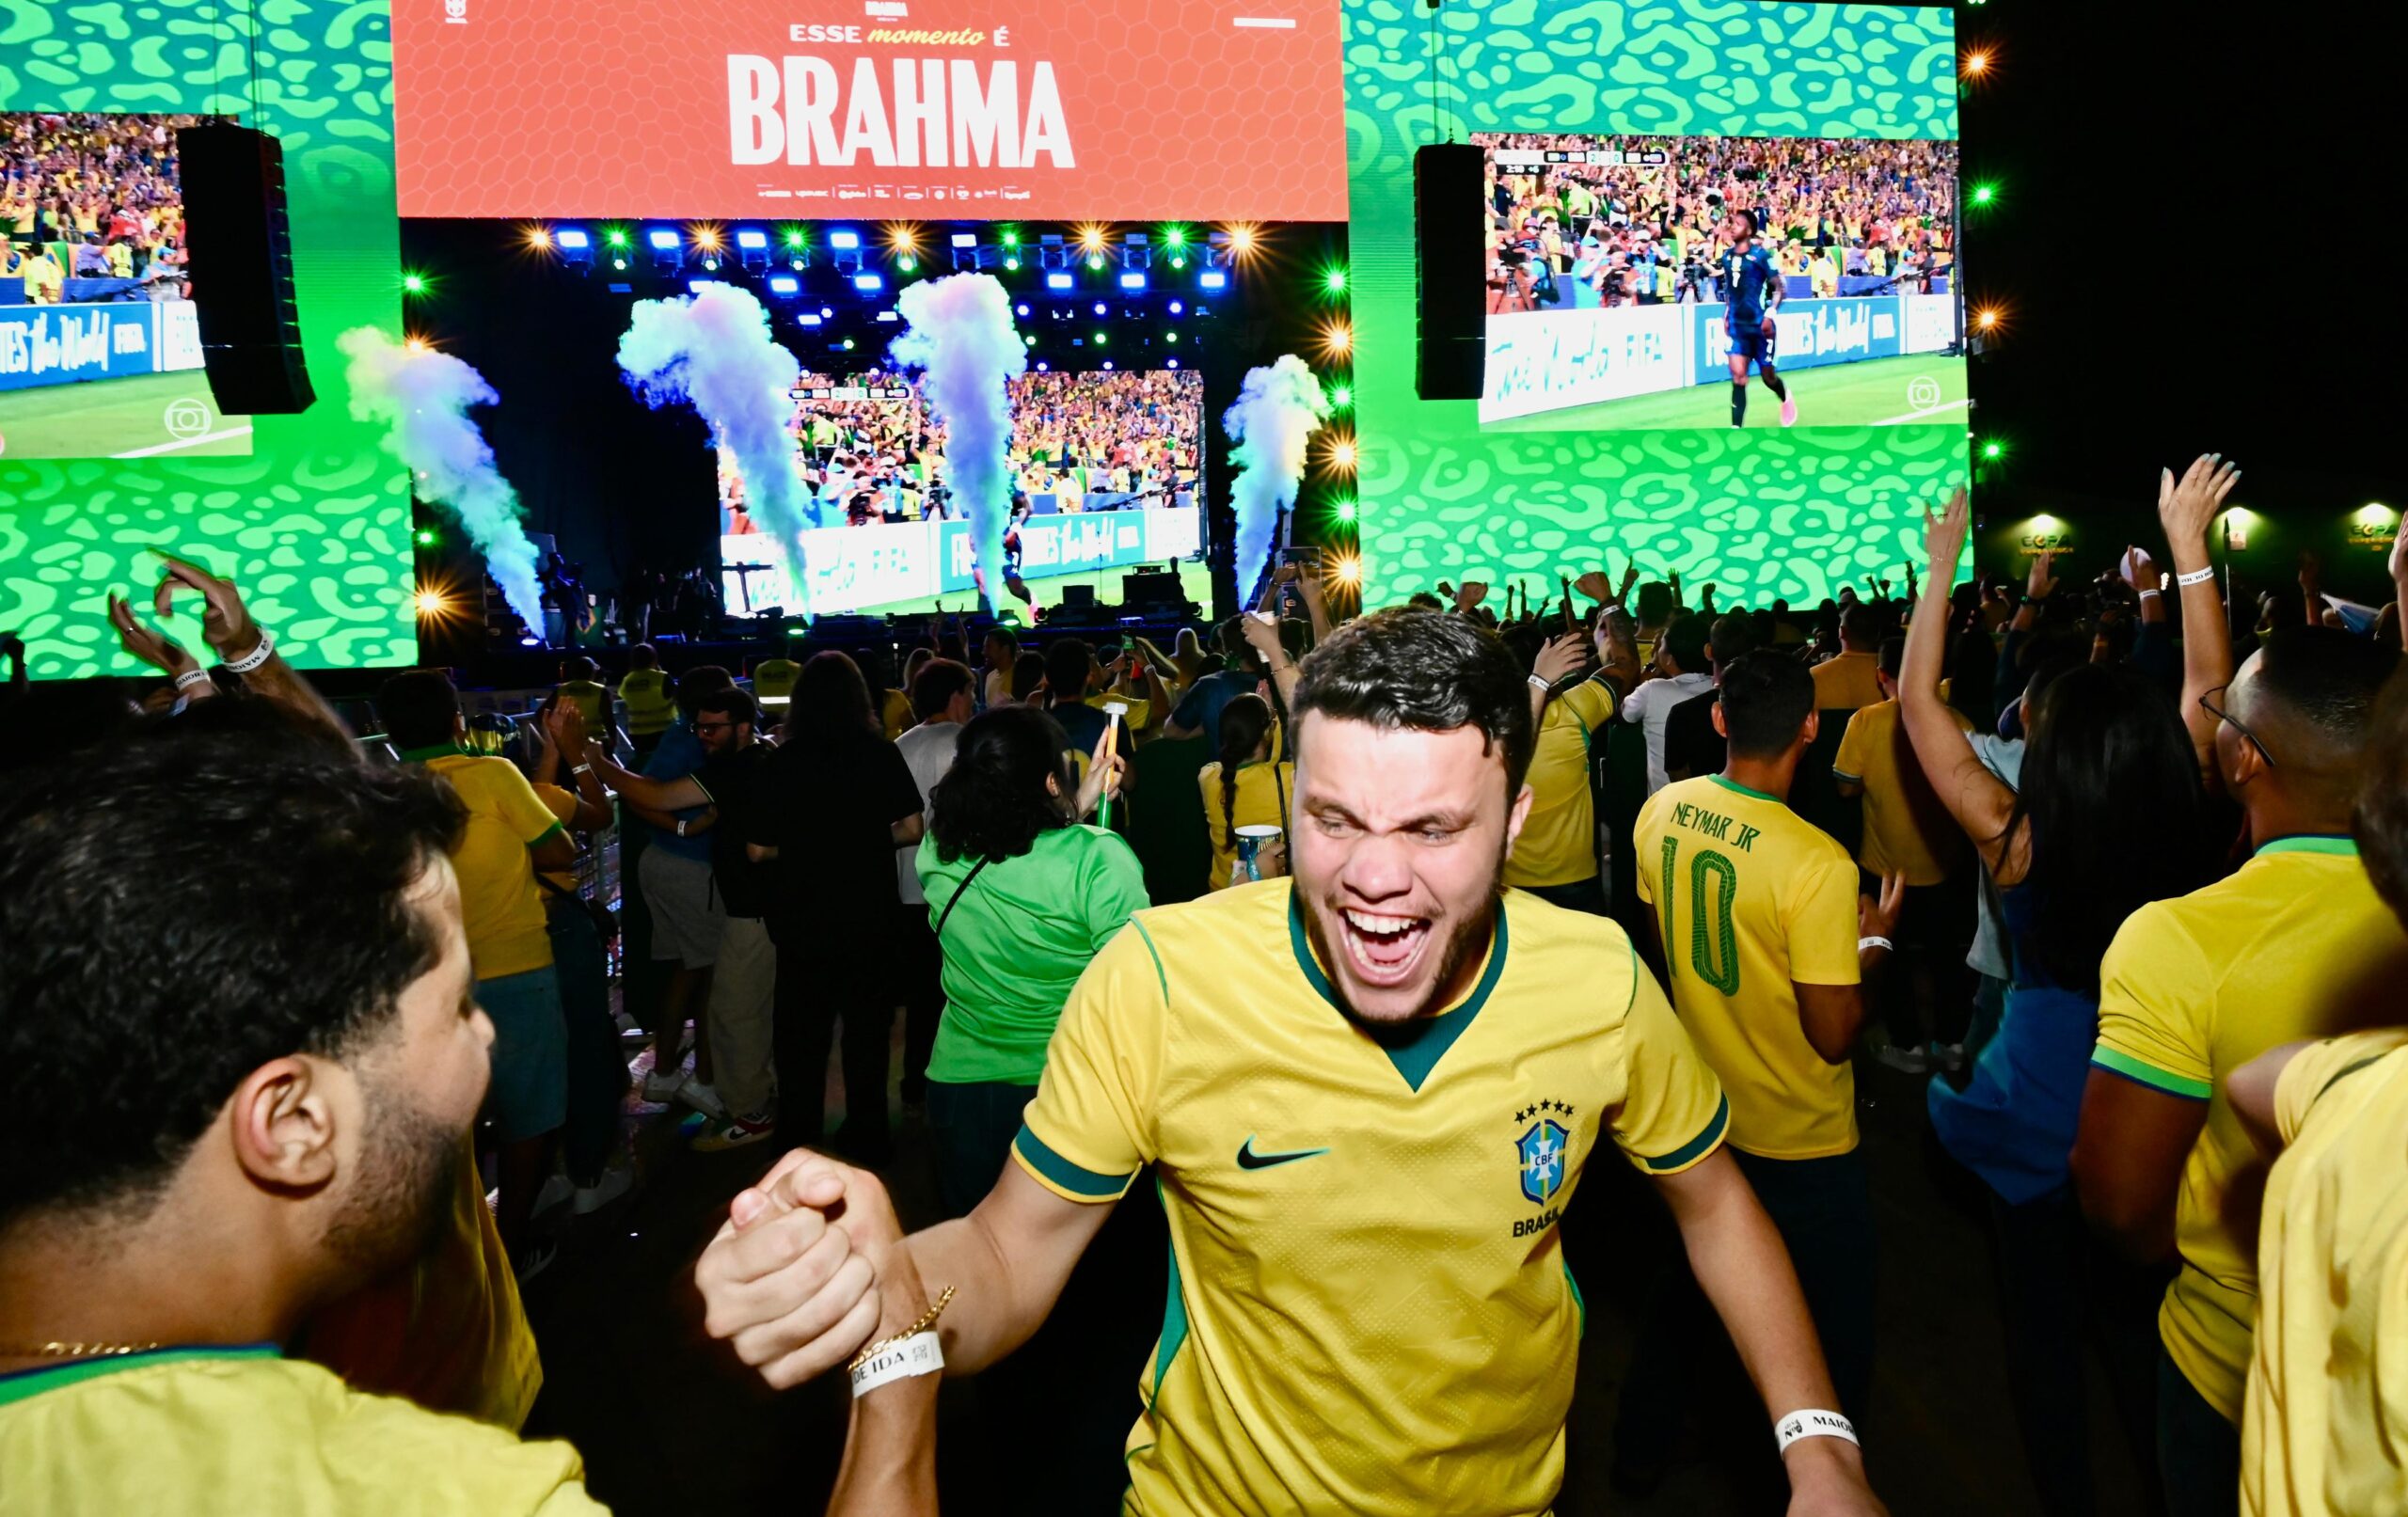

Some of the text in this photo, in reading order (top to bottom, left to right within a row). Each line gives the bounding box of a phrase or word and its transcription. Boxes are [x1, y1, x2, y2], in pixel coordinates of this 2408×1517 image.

[789, 24, 1010, 47] ESSE momento É
[727, 54, 1076, 168] BRAHMA
[1671, 801, 1761, 852] NEYMAR JR
[1661, 835, 1739, 997] 10
[1535, 1153, 1553, 1166] CBF
[872, 1351, 905, 1373] IDA
